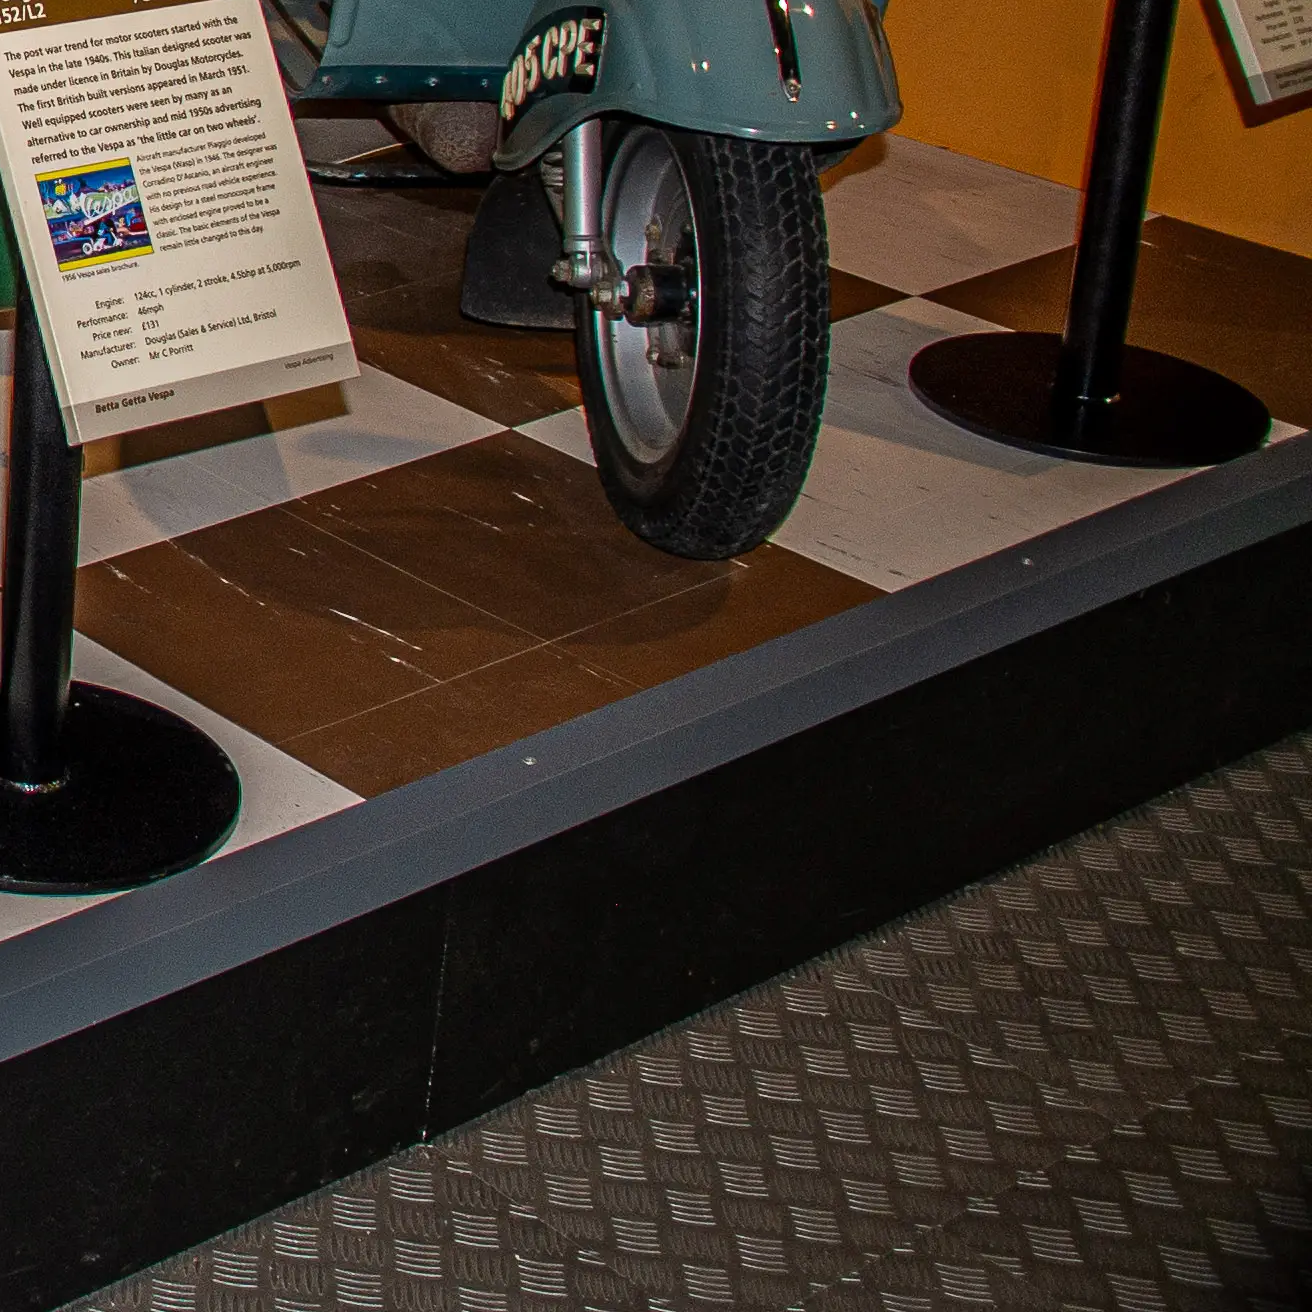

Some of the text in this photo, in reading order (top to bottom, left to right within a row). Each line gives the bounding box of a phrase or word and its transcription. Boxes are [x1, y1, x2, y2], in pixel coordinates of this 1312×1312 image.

[13, 49, 243, 96] made under licence in Britain by Douglas Motorcycles.
[542, 17, 602, 81] CPE
[16, 64, 250, 112] The first British built versions appeared in March 1951.
[94, 389, 174, 413] Betta Getta Vespa
